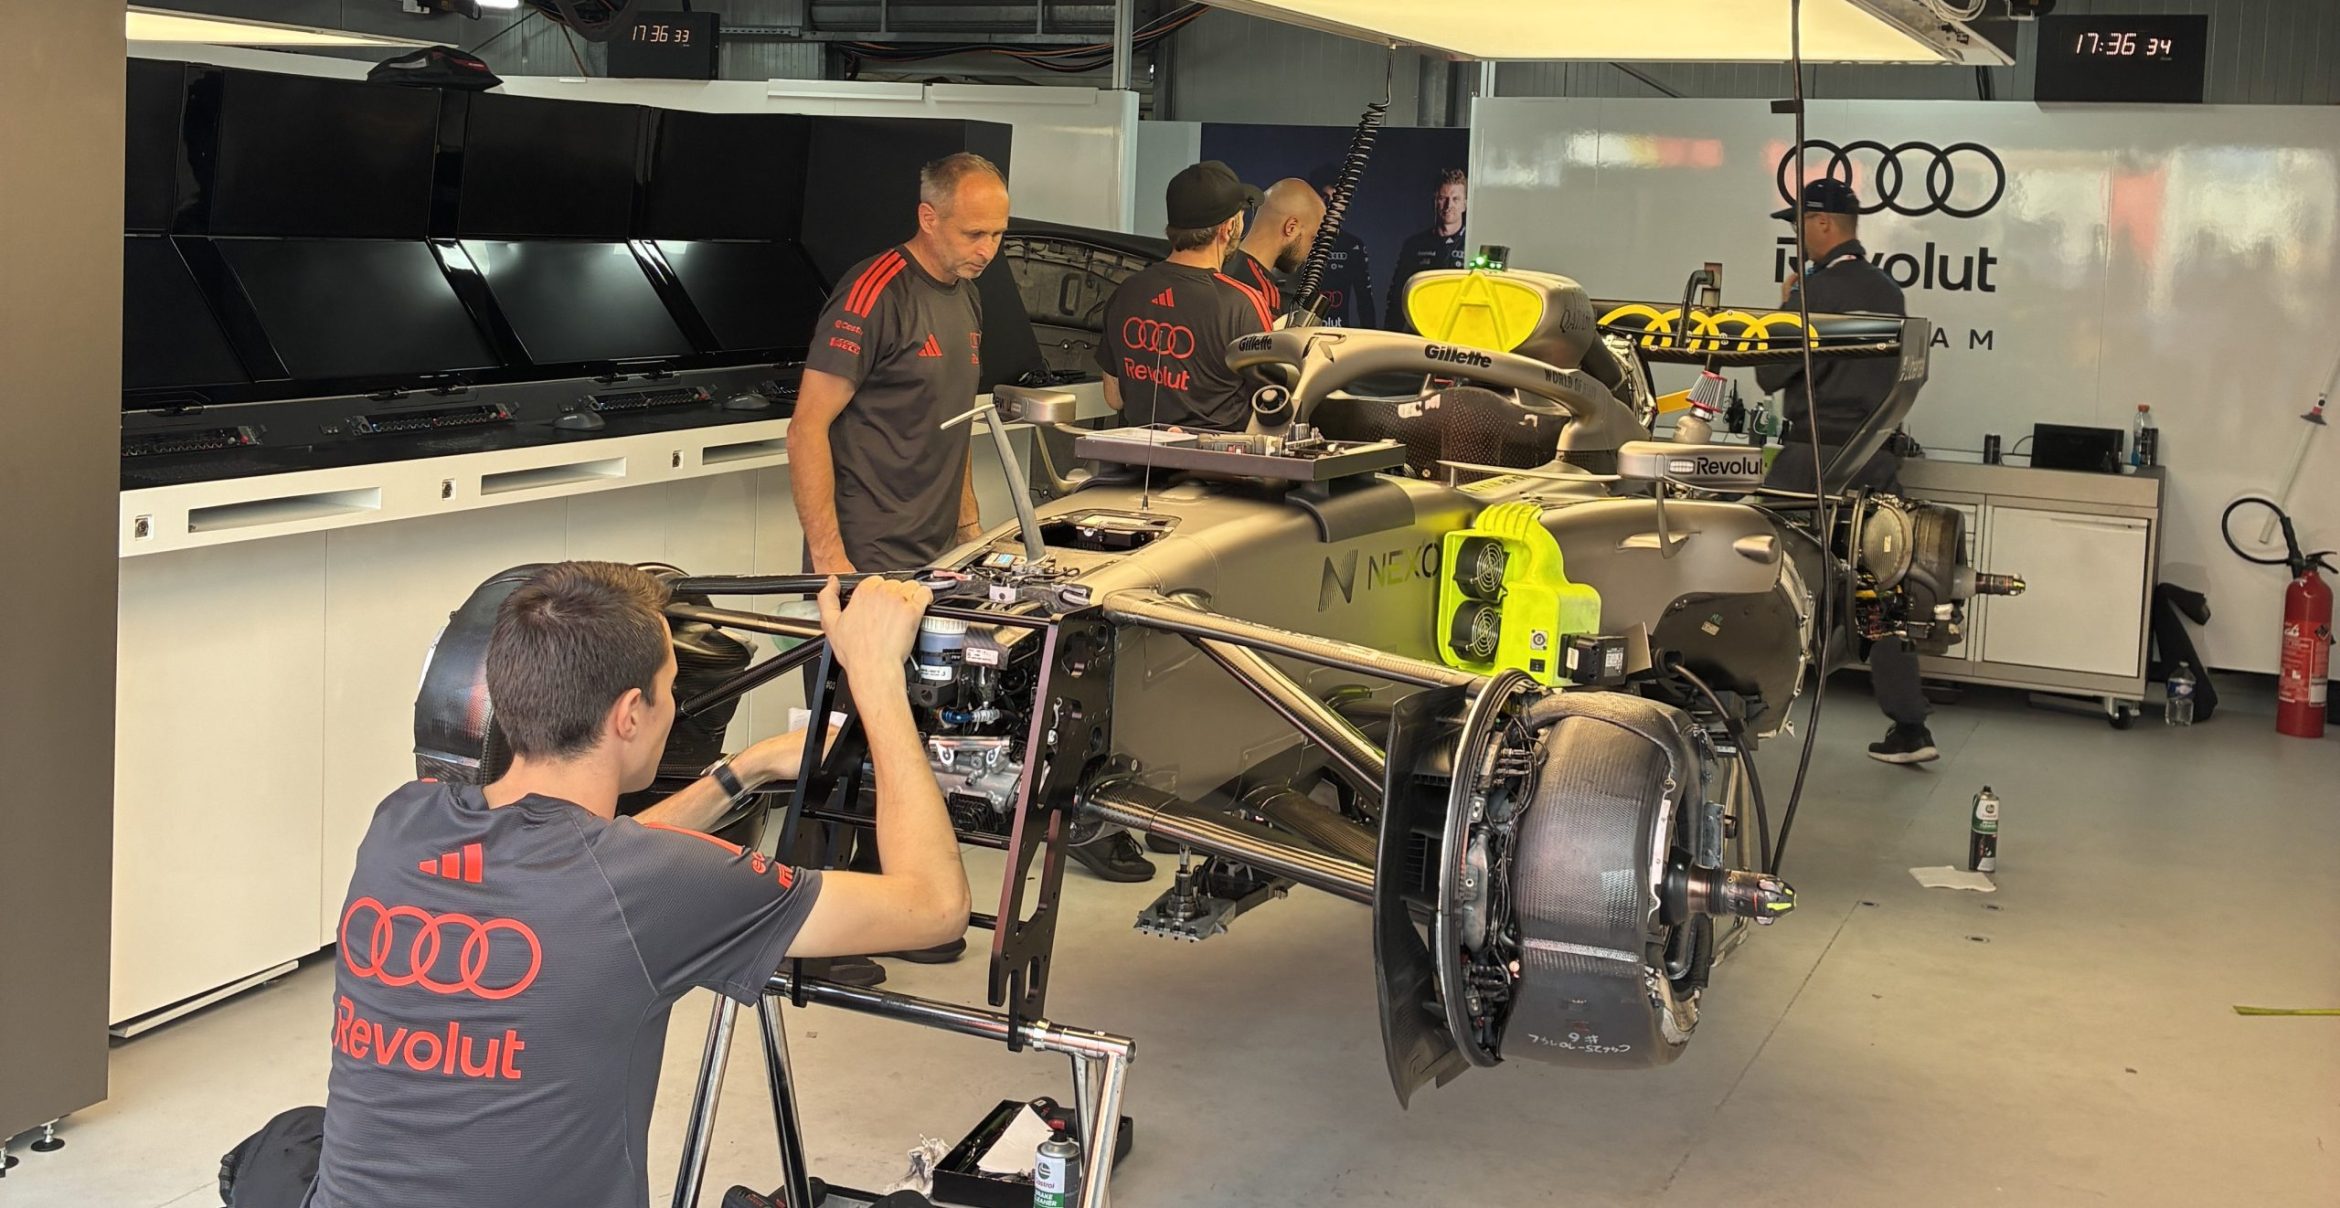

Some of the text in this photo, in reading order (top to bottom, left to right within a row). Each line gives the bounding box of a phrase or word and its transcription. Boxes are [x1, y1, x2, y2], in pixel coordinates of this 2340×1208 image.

[674, 30, 690, 43] 33
[2076, 33, 2172, 55] 17:36 34
[1239, 335, 1273, 351] Gillette
[1424, 344, 1492, 368] Gillette
[1124, 357, 1191, 391] Revolut
[1368, 542, 1440, 590] NEXO
[334, 995, 525, 1079] Revolut
